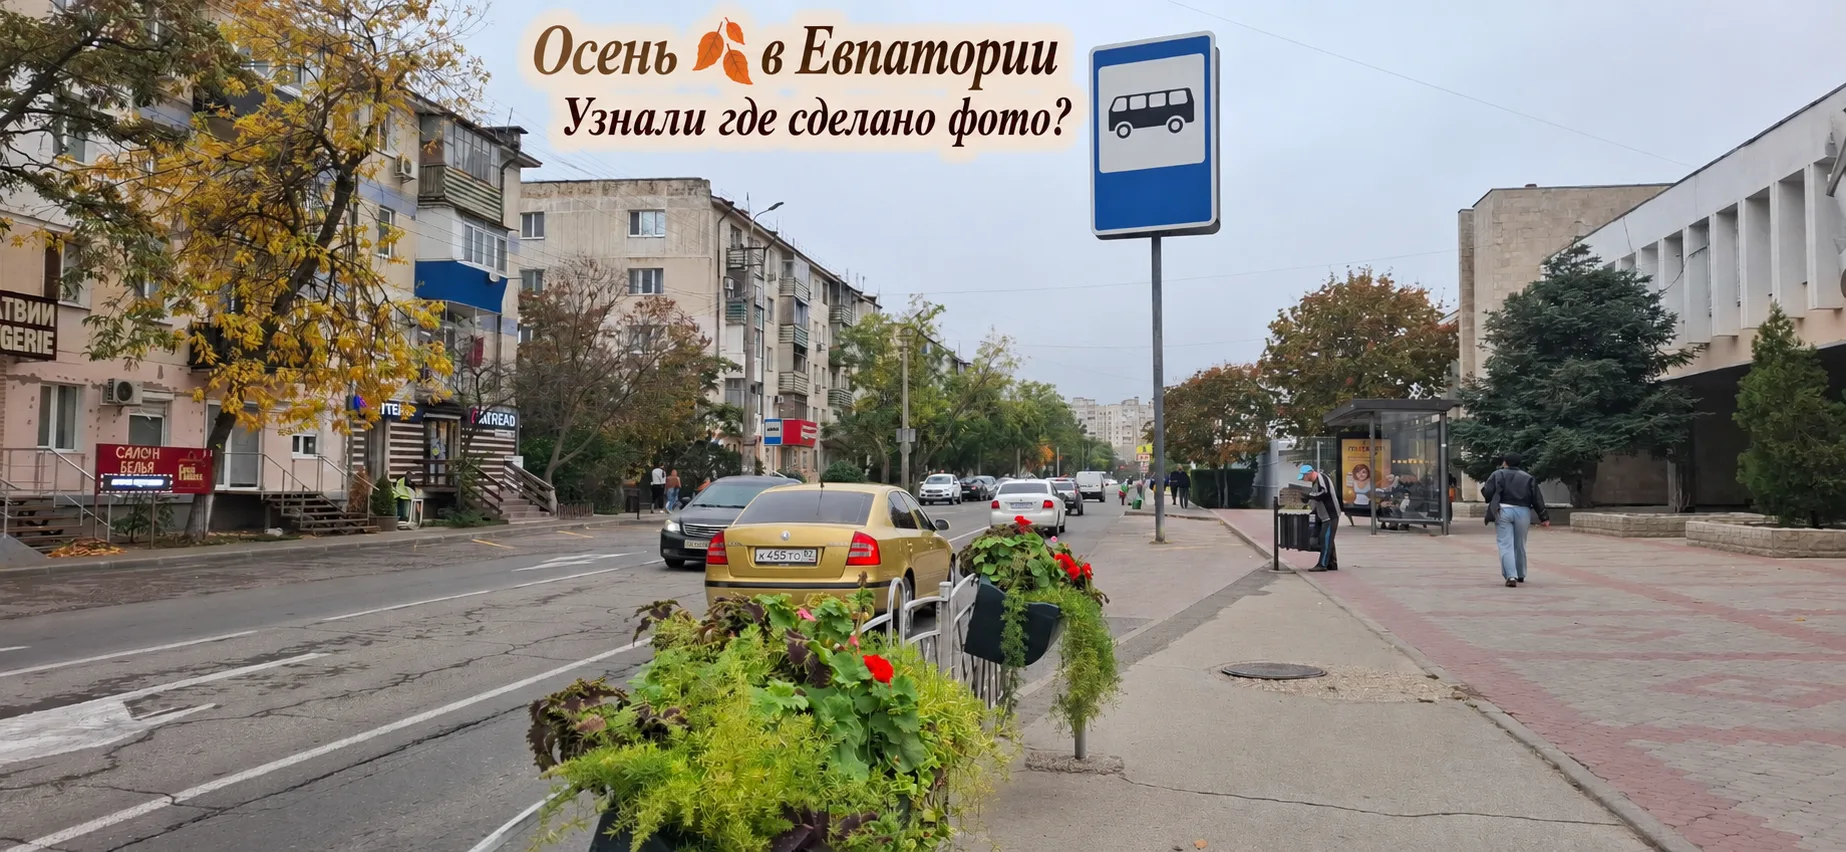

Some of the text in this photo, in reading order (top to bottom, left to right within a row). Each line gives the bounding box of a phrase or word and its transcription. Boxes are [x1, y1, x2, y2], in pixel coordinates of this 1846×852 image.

[0, 324, 54, 355] GERIE
[115, 446, 160, 460] САЛОН
[120, 460, 155, 474] БЕЛЬЯ
